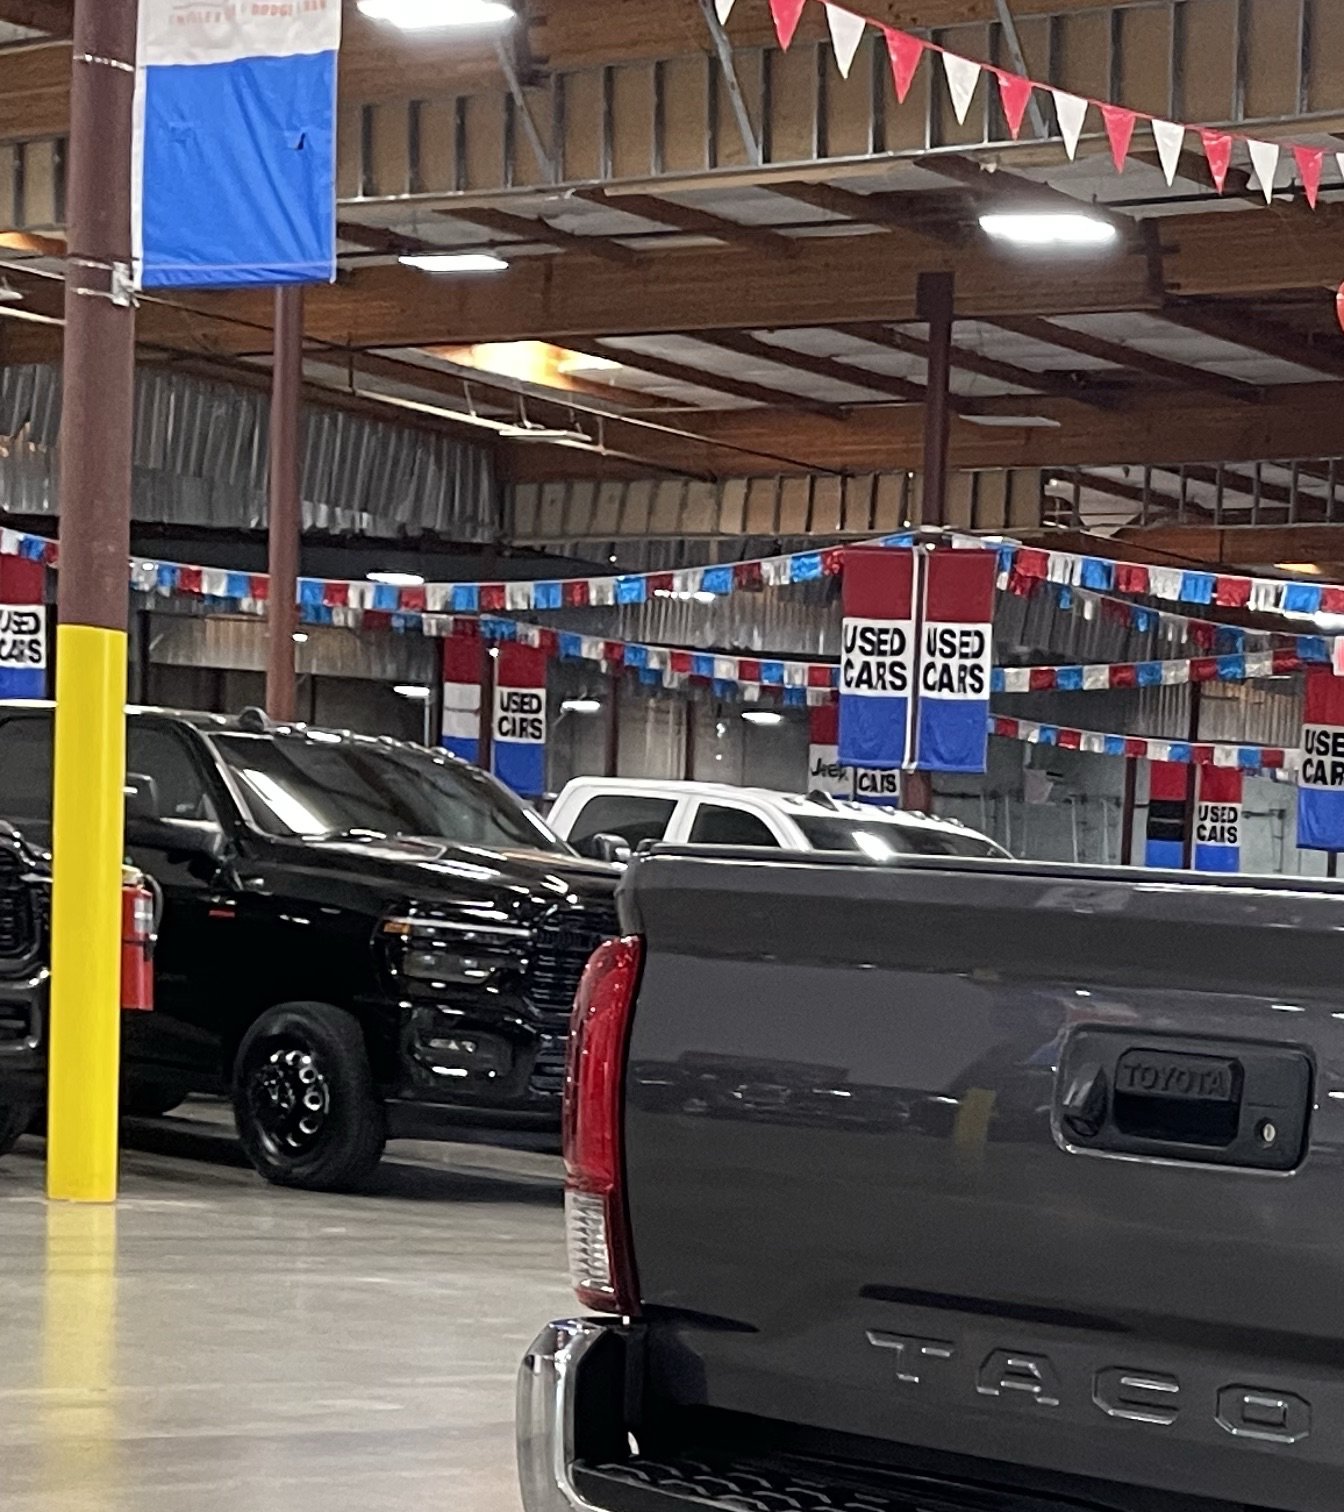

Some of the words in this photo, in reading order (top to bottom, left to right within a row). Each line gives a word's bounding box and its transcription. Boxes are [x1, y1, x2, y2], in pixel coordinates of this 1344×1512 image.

[843, 625, 906, 657] USED
[926, 627, 985, 660] USED
[843, 658, 908, 692] CARS
[923, 661, 985, 694] CARS
[501, 691, 543, 715] USED
[1198, 805, 1238, 823] USED
[1123, 1062, 1229, 1097] TOYOTA
